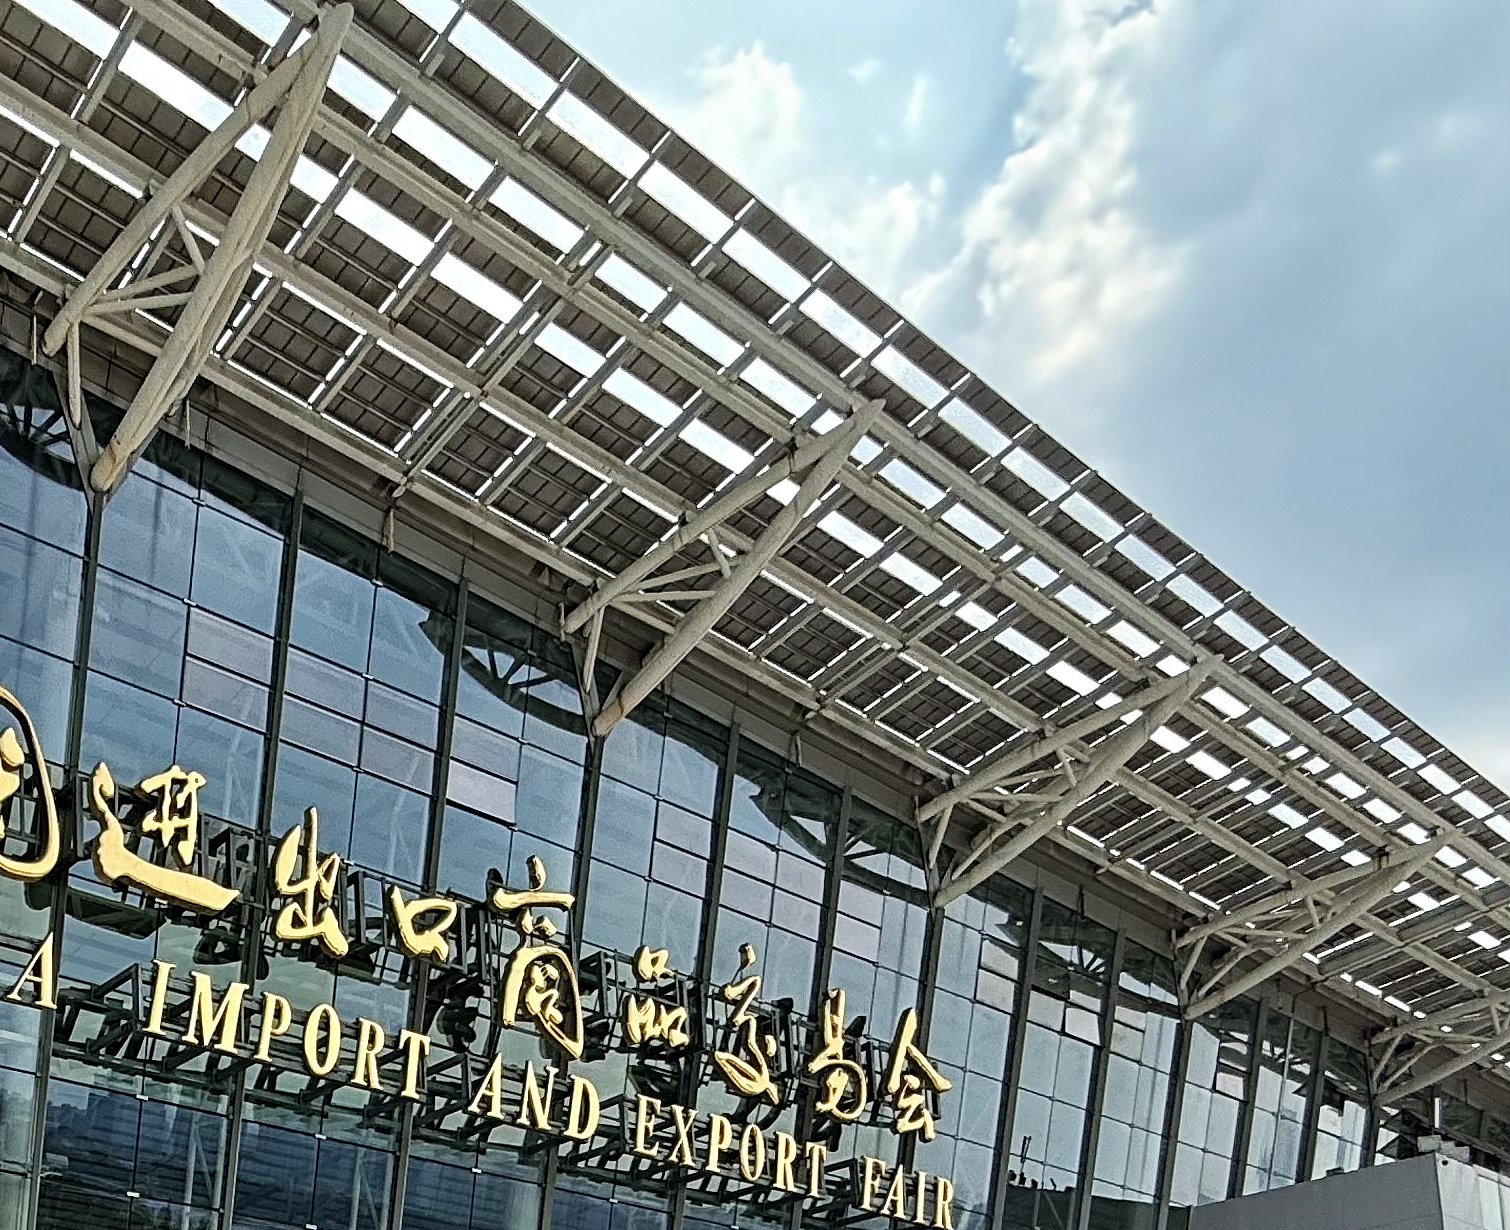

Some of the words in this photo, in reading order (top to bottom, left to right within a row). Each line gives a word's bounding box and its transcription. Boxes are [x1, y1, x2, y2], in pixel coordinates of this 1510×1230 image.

[142, 958, 432, 1101] IMPORT
[468, 1051, 601, 1142] AND
[633, 1092, 829, 1199] EXPORT
